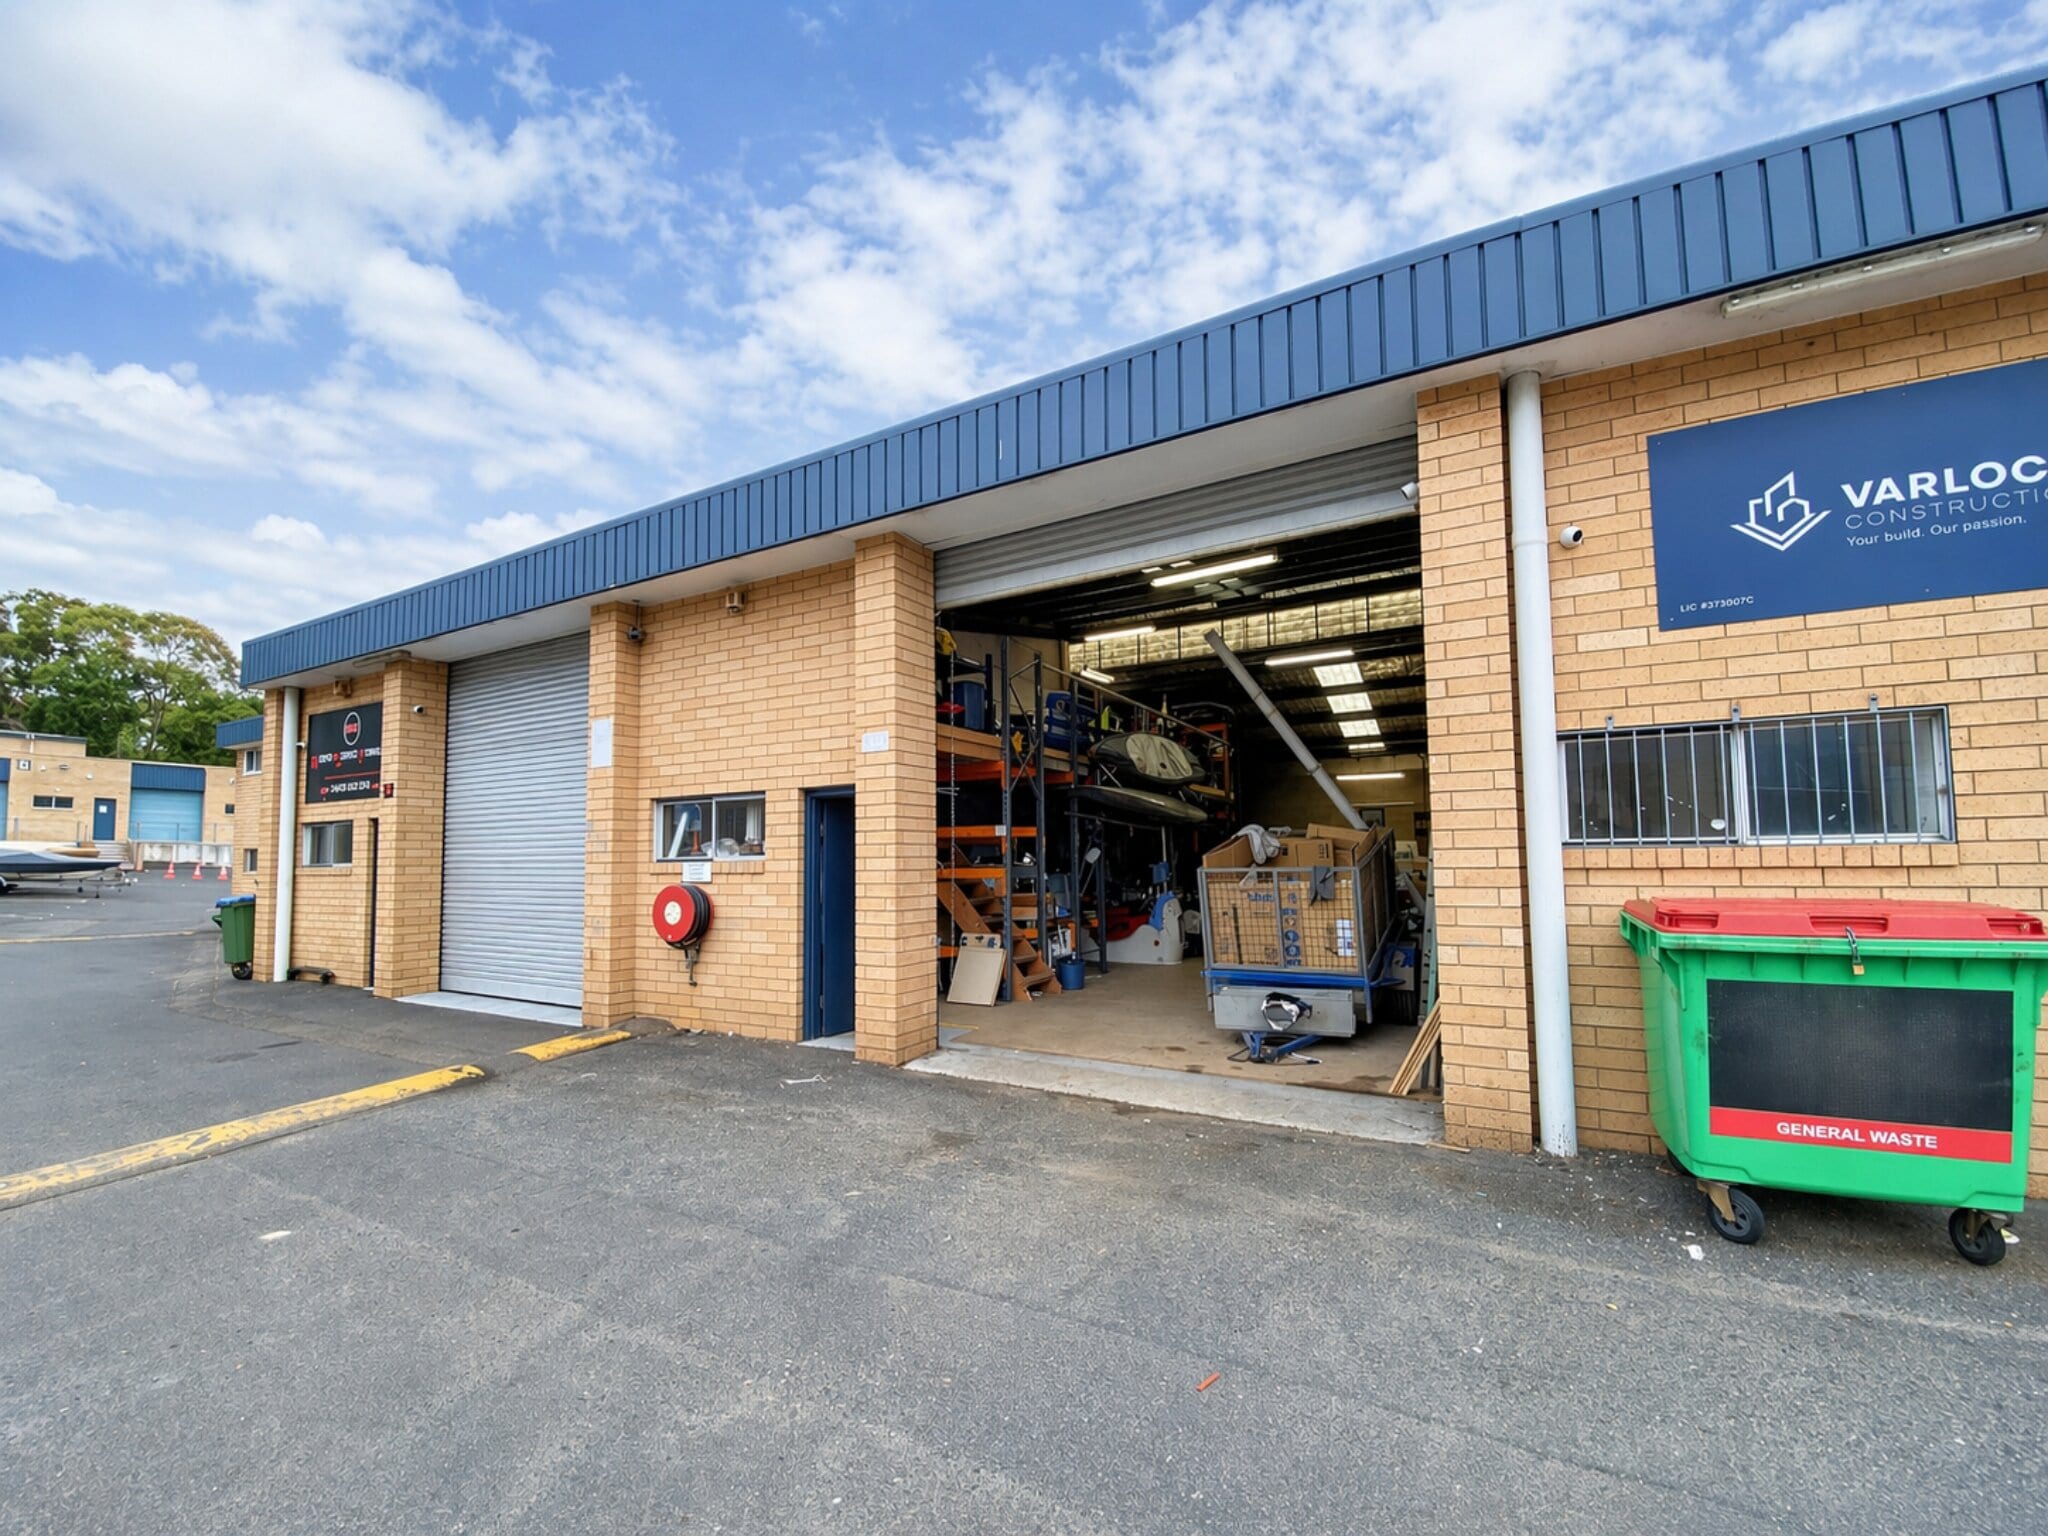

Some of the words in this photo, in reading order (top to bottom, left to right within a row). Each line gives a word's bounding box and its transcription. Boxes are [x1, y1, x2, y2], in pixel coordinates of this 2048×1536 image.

[1840, 454, 2048, 509] VARLOC
[1845, 488, 2048, 530] CONSTRUCTI
[1846, 534, 1880, 547] Your
[1884, 527, 1925, 543] build.
[1930, 522, 1959, 536] Our
[1963, 515, 2028, 533] passion.
[1776, 1122, 1866, 1142] GENERAL
[1869, 1130, 1938, 1149] WASTE
